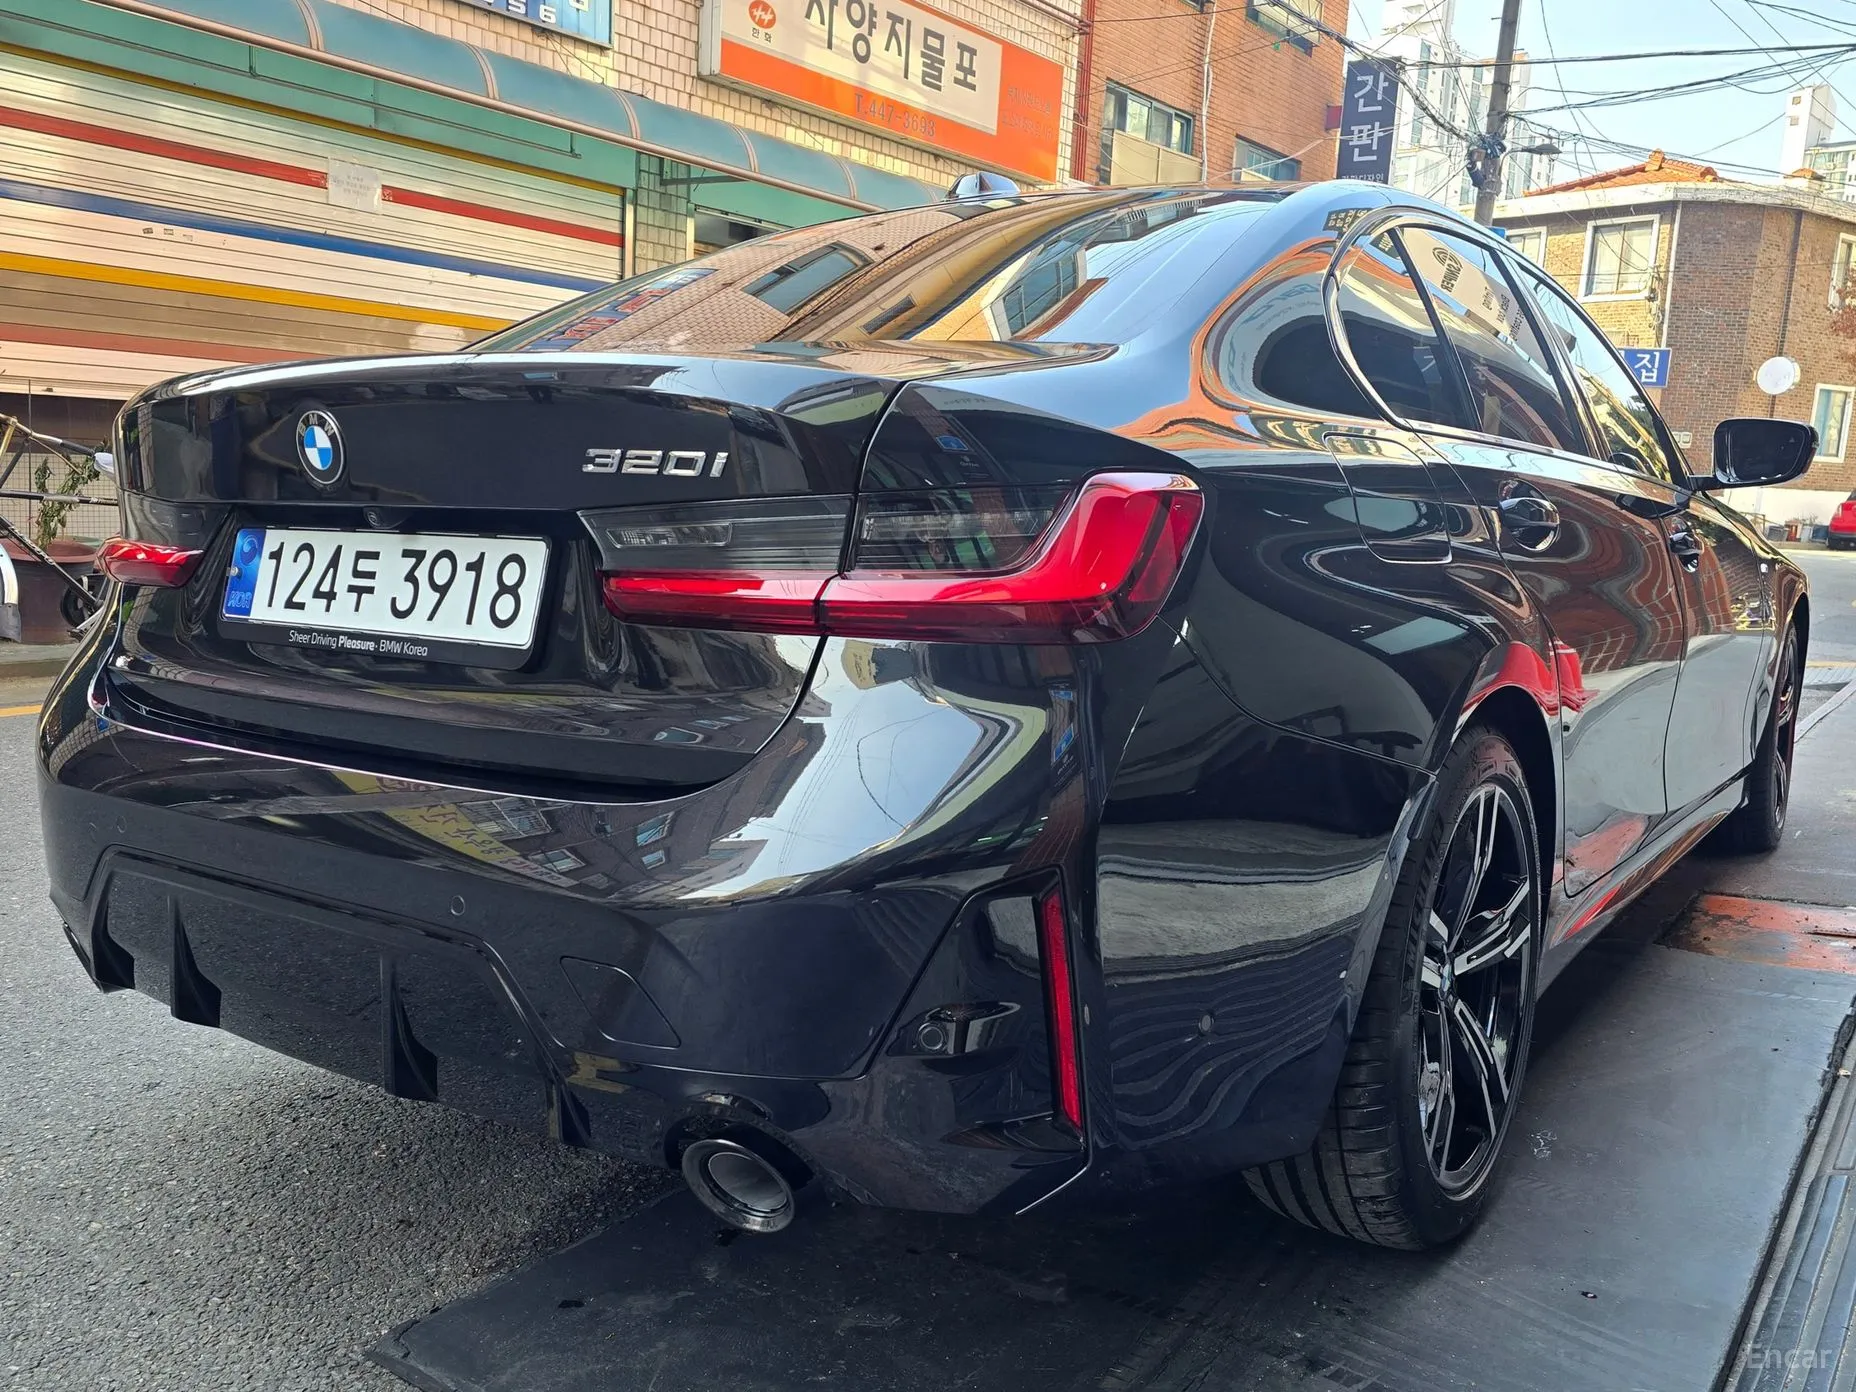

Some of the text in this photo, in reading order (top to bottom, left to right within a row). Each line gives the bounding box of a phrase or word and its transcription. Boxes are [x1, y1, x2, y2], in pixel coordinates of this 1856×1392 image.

[1349, 71, 1389, 162] 간판
[1618, 351, 1660, 383] 집
[298, 413, 335, 437] BMW
[582, 448, 729, 478] 320i
[266, 541, 527, 629] 124두 3918
[289, 630, 311, 644] Sheer
[311, 633, 336, 649] Driving
[380, 640, 402, 653] BMW
[403, 643, 428, 657] Korea
